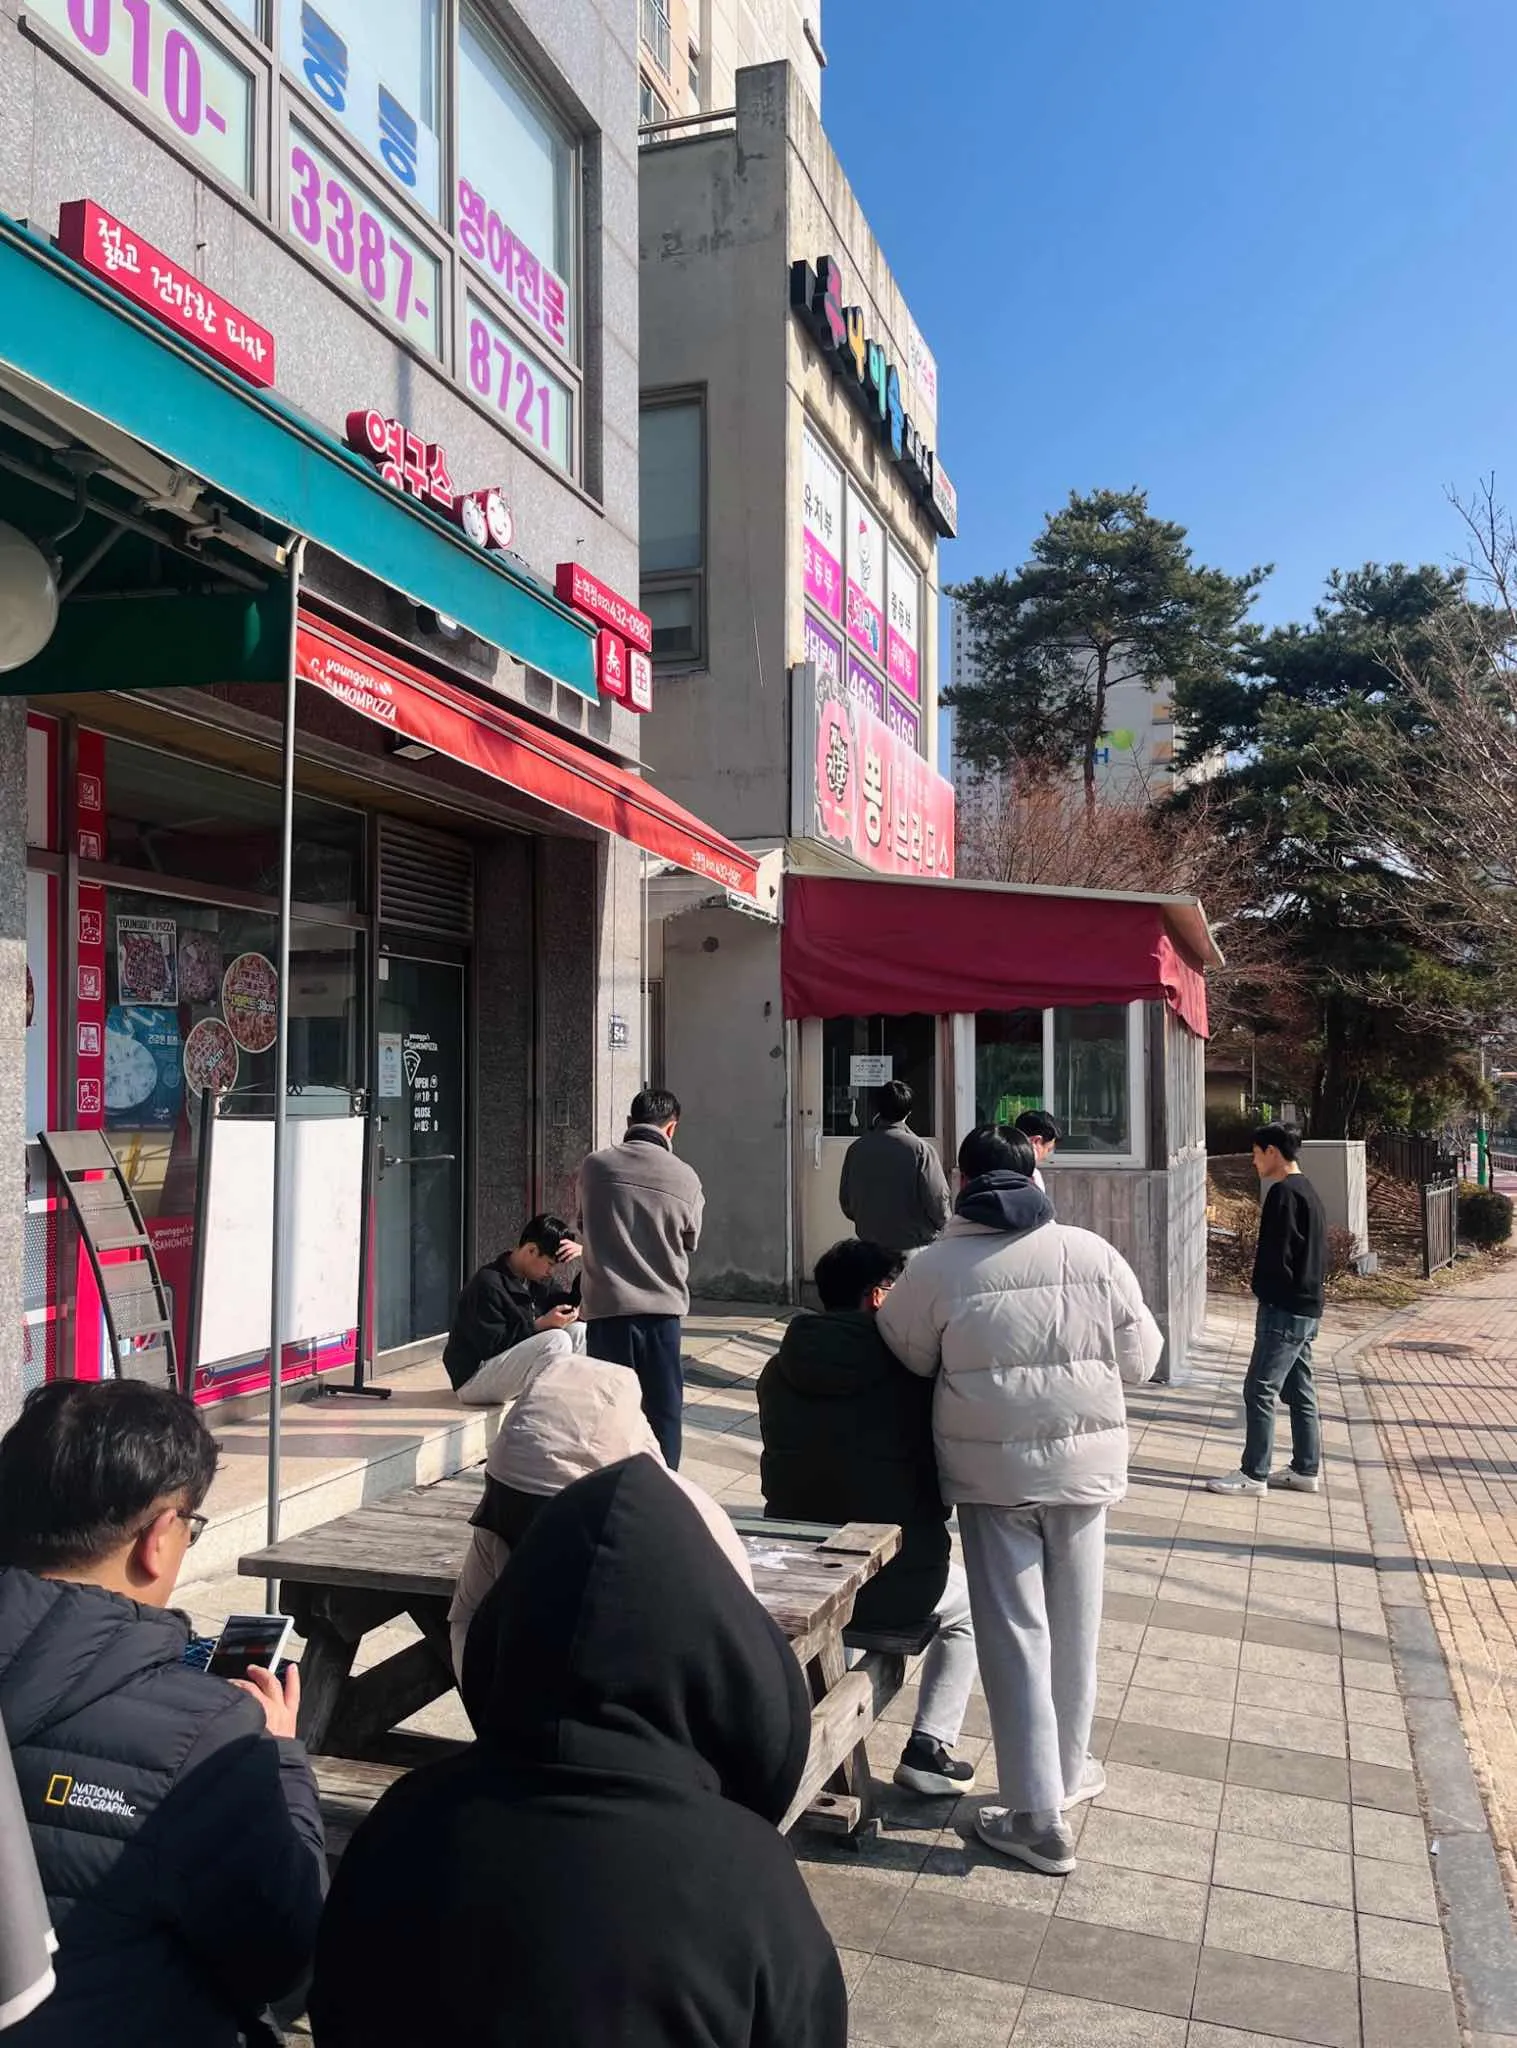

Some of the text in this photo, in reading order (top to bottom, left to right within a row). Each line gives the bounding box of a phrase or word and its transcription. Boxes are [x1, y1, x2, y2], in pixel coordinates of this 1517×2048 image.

[457, 175, 566, 347] 영어전문
[150, 265, 217, 335] 건강한
[223, 316, 267, 364] 피자
[290, 146, 430, 324] 3387-
[470, 317, 551, 450] 8721
[365, 409, 454, 510] 영구스
[888, 703, 915, 749] 3169
[414, 1076, 430, 1089] OPEN
[414, 1106, 431, 1119] CLOSE
[68, 1792, 137, 1818] GEOGRAPHIC
[72, 1781, 126, 1803] NATIONAL
